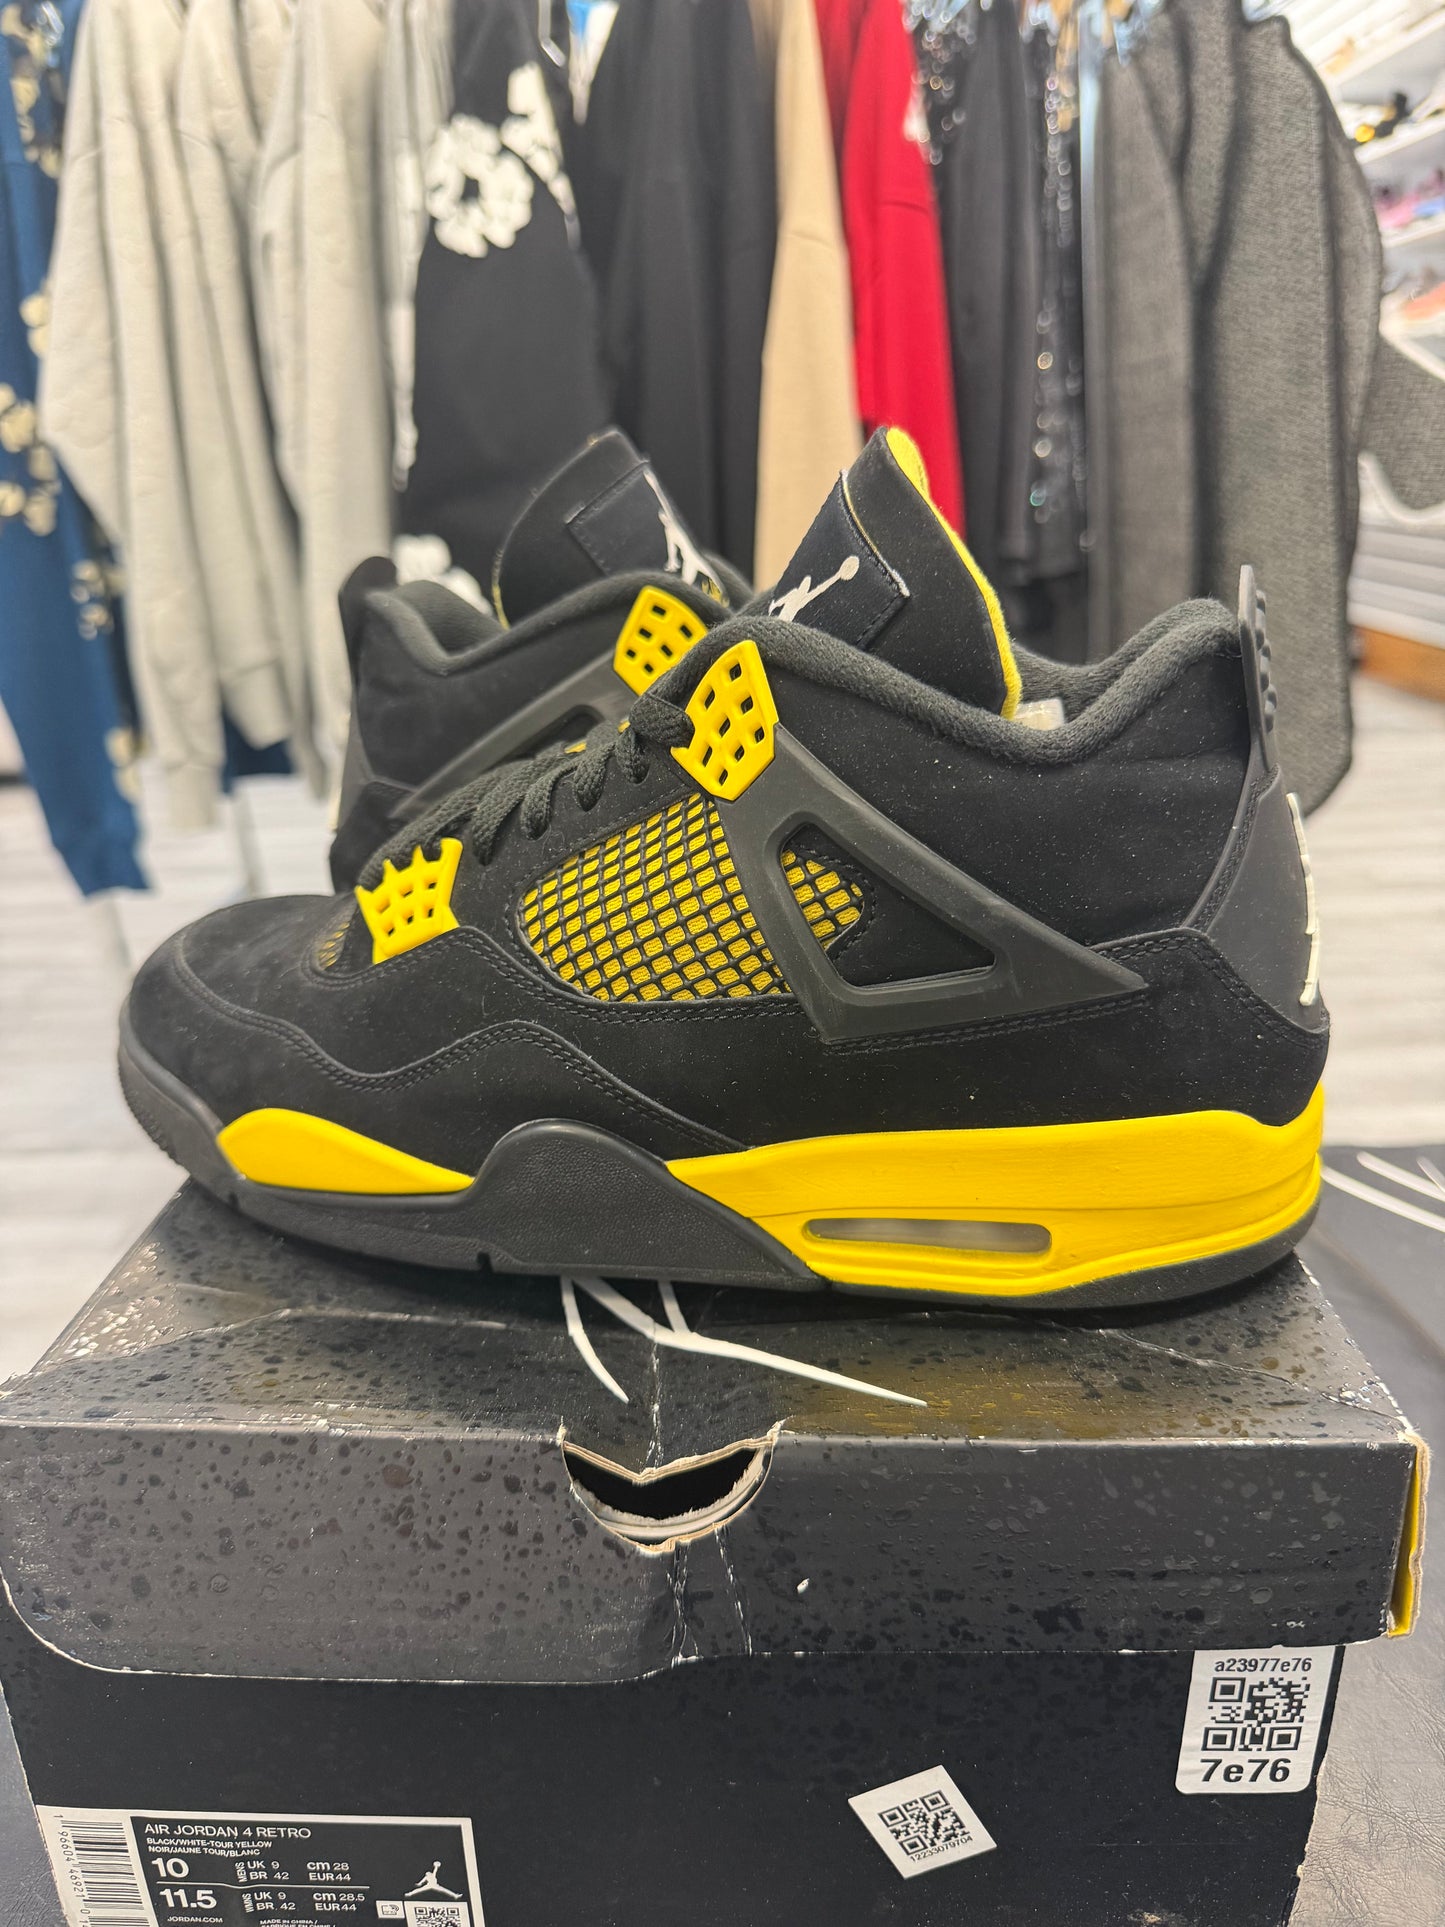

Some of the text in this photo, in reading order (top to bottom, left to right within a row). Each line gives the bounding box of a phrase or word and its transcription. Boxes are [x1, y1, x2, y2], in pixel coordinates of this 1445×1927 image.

[1214, 1657, 1312, 1673] a23977e76
[1200, 1758, 1291, 1783] 7e76
[144, 1823, 312, 1839] AIR JORDAN 4 RETRO
[146, 1837, 273, 1849] BLACK/WHITE-TOUR YELLOW
[148, 1845, 261, 1858] NOIR/JAUNE TOUR/BLANC
[58, 1830, 76, 1862] 96604
[69, 1868, 86, 1898] 46921
[151, 1857, 190, 1878] 10
[247, 1860, 280, 1870] UK 9
[306, 1861, 350, 1871] cm 28
[235, 1861, 248, 1883] MENS
[249, 1871, 290, 1880] BR 42
[159, 1888, 217, 1909] 11.5
[254, 1891, 287, 1900] UK 9
[312, 1892, 366, 1902] cm 28.5
[280, 1902, 297, 1911] 42
[167, 1915, 224, 1923] JORDAN.COM
